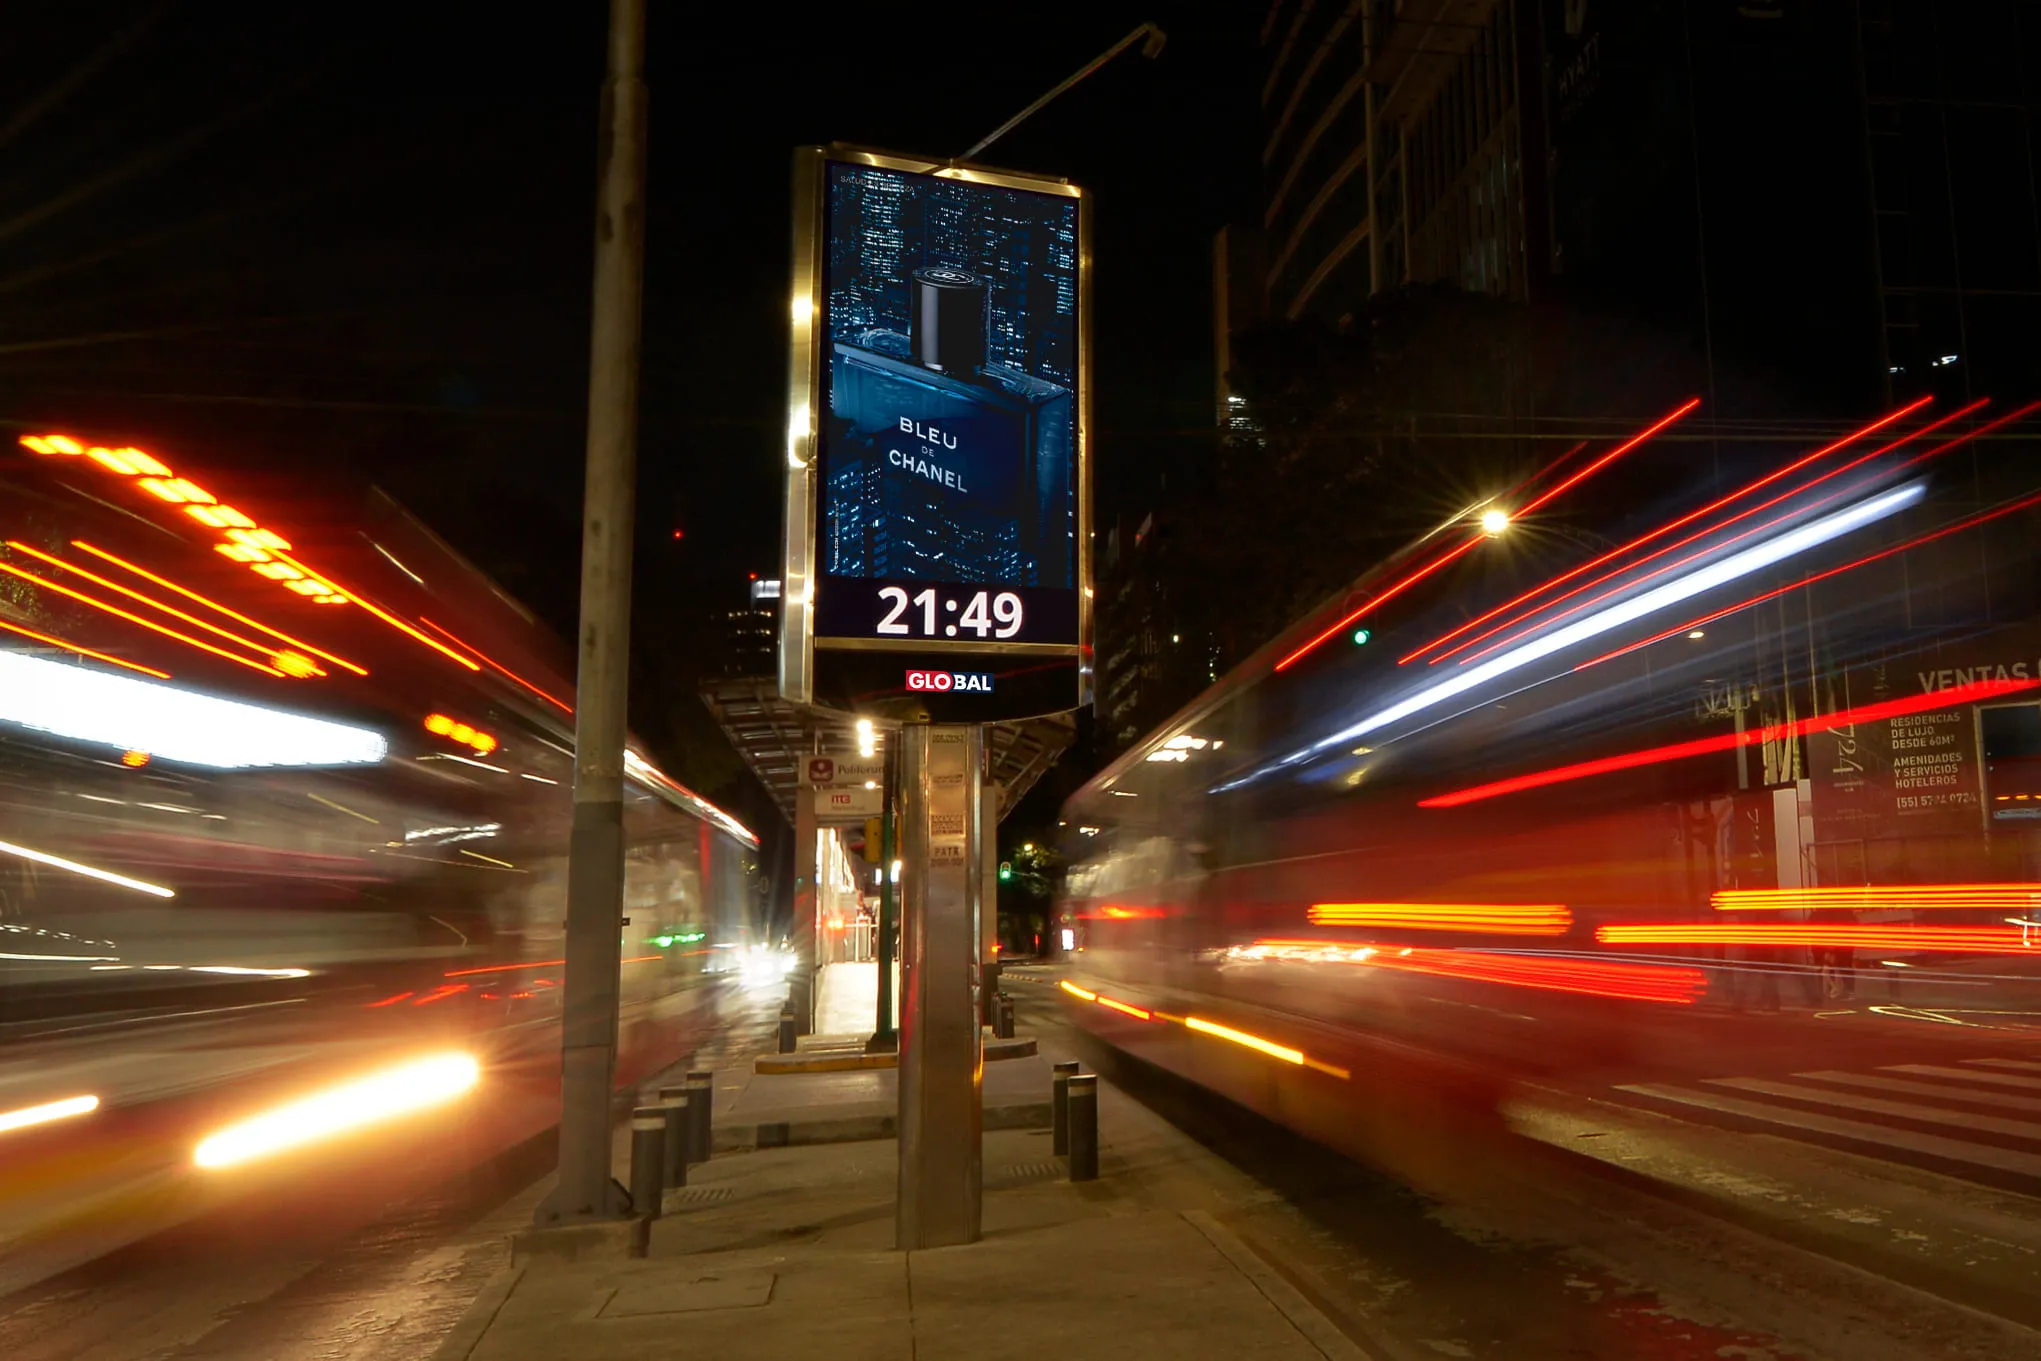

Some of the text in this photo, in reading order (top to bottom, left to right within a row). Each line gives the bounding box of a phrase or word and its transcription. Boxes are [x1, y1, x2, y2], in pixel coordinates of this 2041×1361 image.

[900, 416, 957, 450] BLEU
[921, 445, 935, 458] DE
[889, 449, 968, 493] CHANEL
[876, 586, 1023, 639] 21:49
[908, 672, 992, 692] GLOBAL
[1917, 661, 2029, 696] VENTAS
[1890, 712, 1961, 728] RESIDENCIAS
[1891, 726, 1935, 739] DE LUJO
[1892, 737, 1928, 750] DESDE
[1893, 752, 1963, 767] AMENIDADES
[1894, 763, 1959, 778] Y SERVICIOS
[1895, 775, 1958, 789] HOTELEROS
